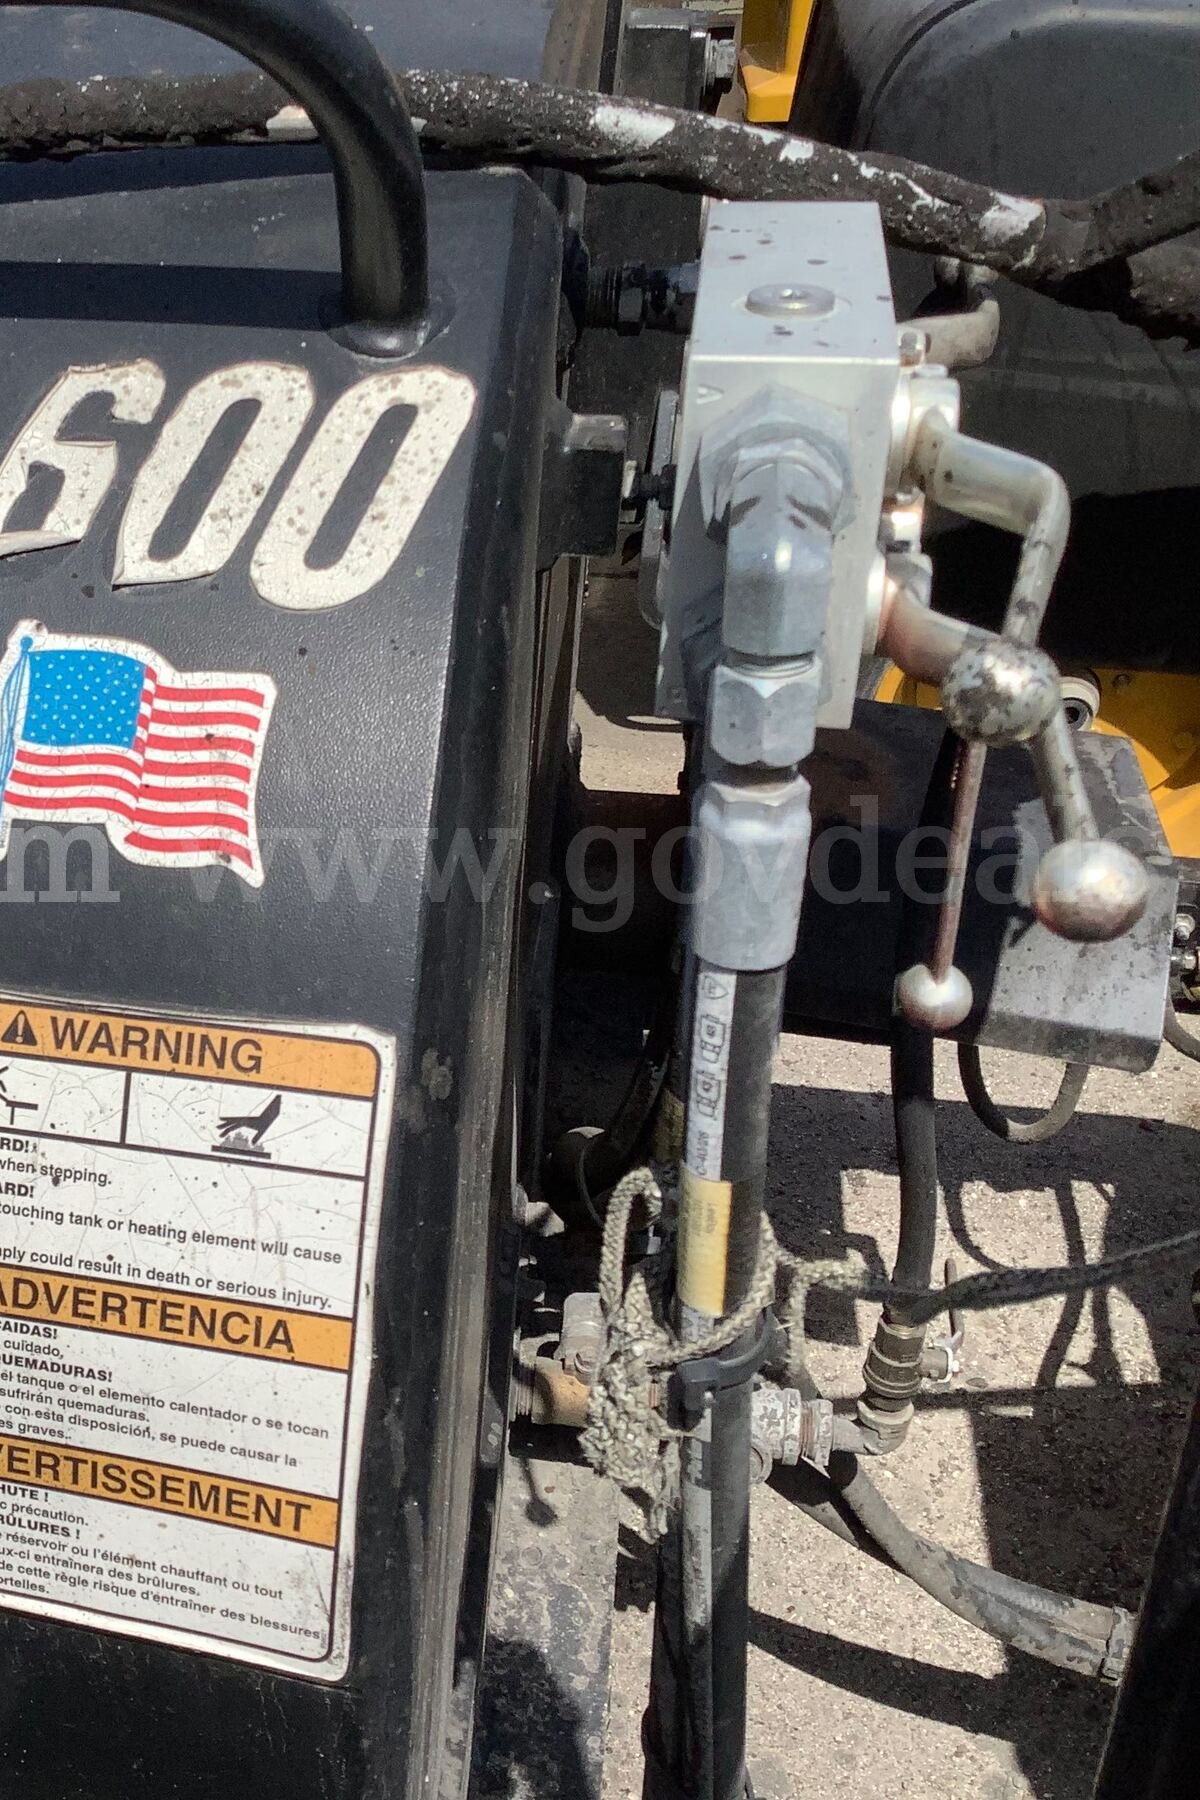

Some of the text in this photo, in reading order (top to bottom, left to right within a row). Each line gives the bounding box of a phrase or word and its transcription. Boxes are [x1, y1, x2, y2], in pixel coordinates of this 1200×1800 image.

[50, 1016, 263, 1075] WARNING
[39, 1164, 112, 1187] stepping.
[68, 1211, 103, 1228] tank
[106, 1219, 124, 1231] or
[127, 1219, 187, 1244] heating
[191, 1230, 256, 1251] element
[260, 1241, 288, 1256] will
[292, 1247, 341, 1264] cause
[29, 1251, 73, 1267] could
[77, 1257, 122, 1275] result
[126, 1263, 141, 1278] in
[145, 1267, 190, 1286] death
[194, 1277, 213, 1289] or
[216, 1280, 277, 1299] serious
[281, 1287, 331, 1310] injury.
[56, 1398, 149, 1422] quemaduras.
[11, 1503, 88, 1526] précaution.
